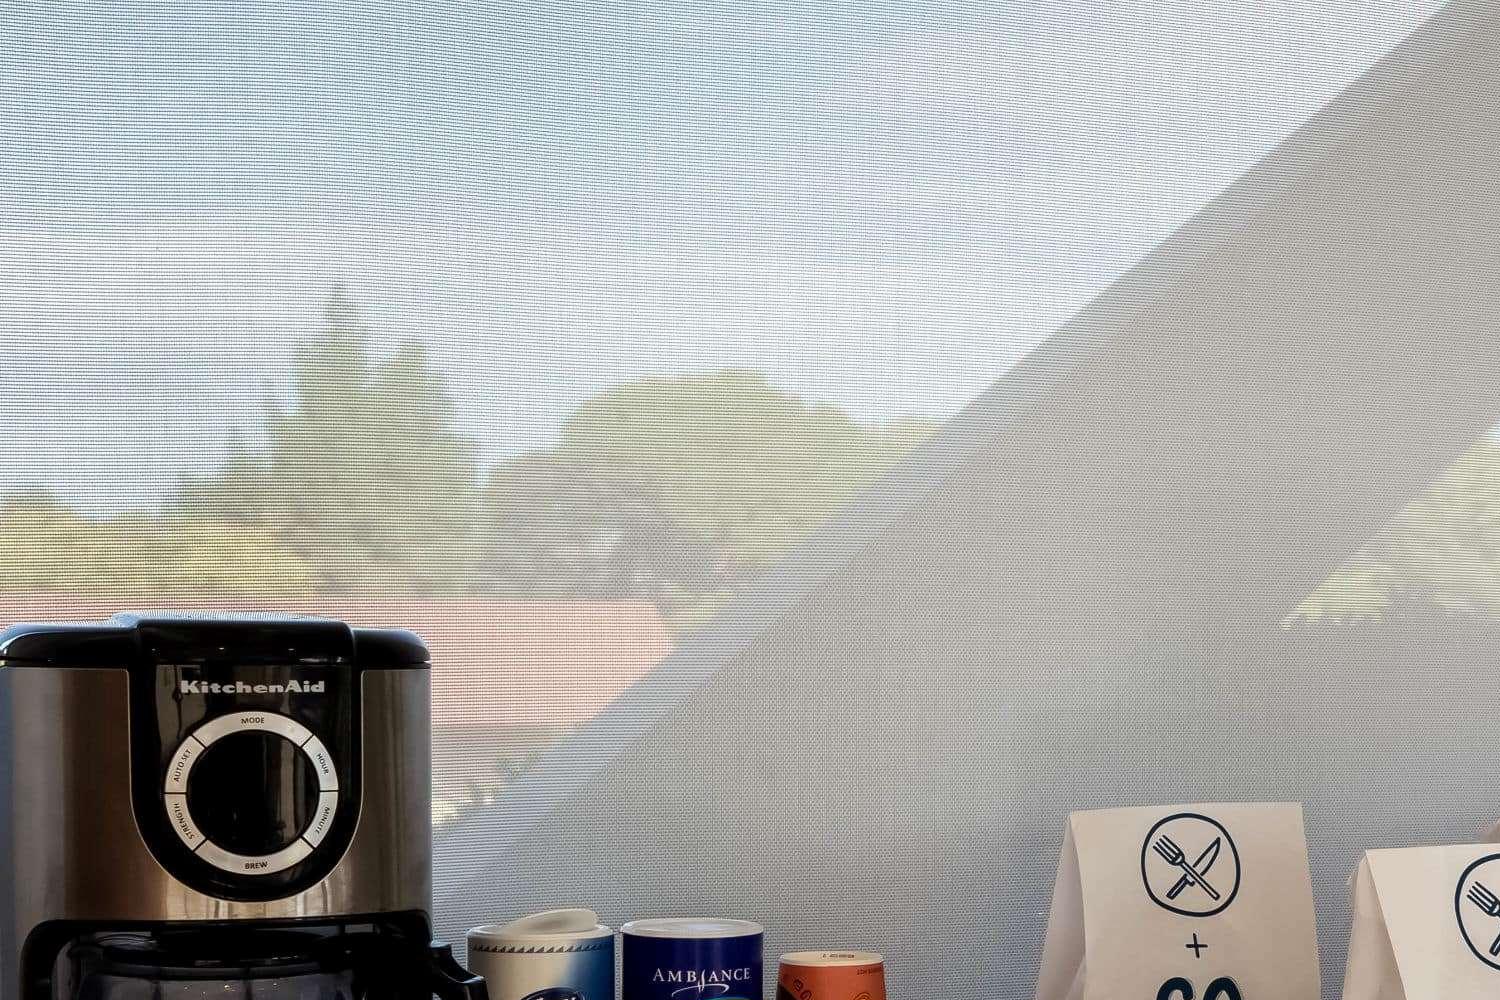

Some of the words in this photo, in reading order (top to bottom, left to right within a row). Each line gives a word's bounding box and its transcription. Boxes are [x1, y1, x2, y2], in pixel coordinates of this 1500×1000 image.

[180, 680, 326, 694] KitchenAid
[241, 716, 265, 724] MODE
[316, 753, 330, 775] HOUR
[174, 803, 195, 840] STRENGTH
[316, 806, 331, 834] MINUTE
[245, 861, 269, 870] BREW
[652, 967, 751, 989] AMBIANCE
